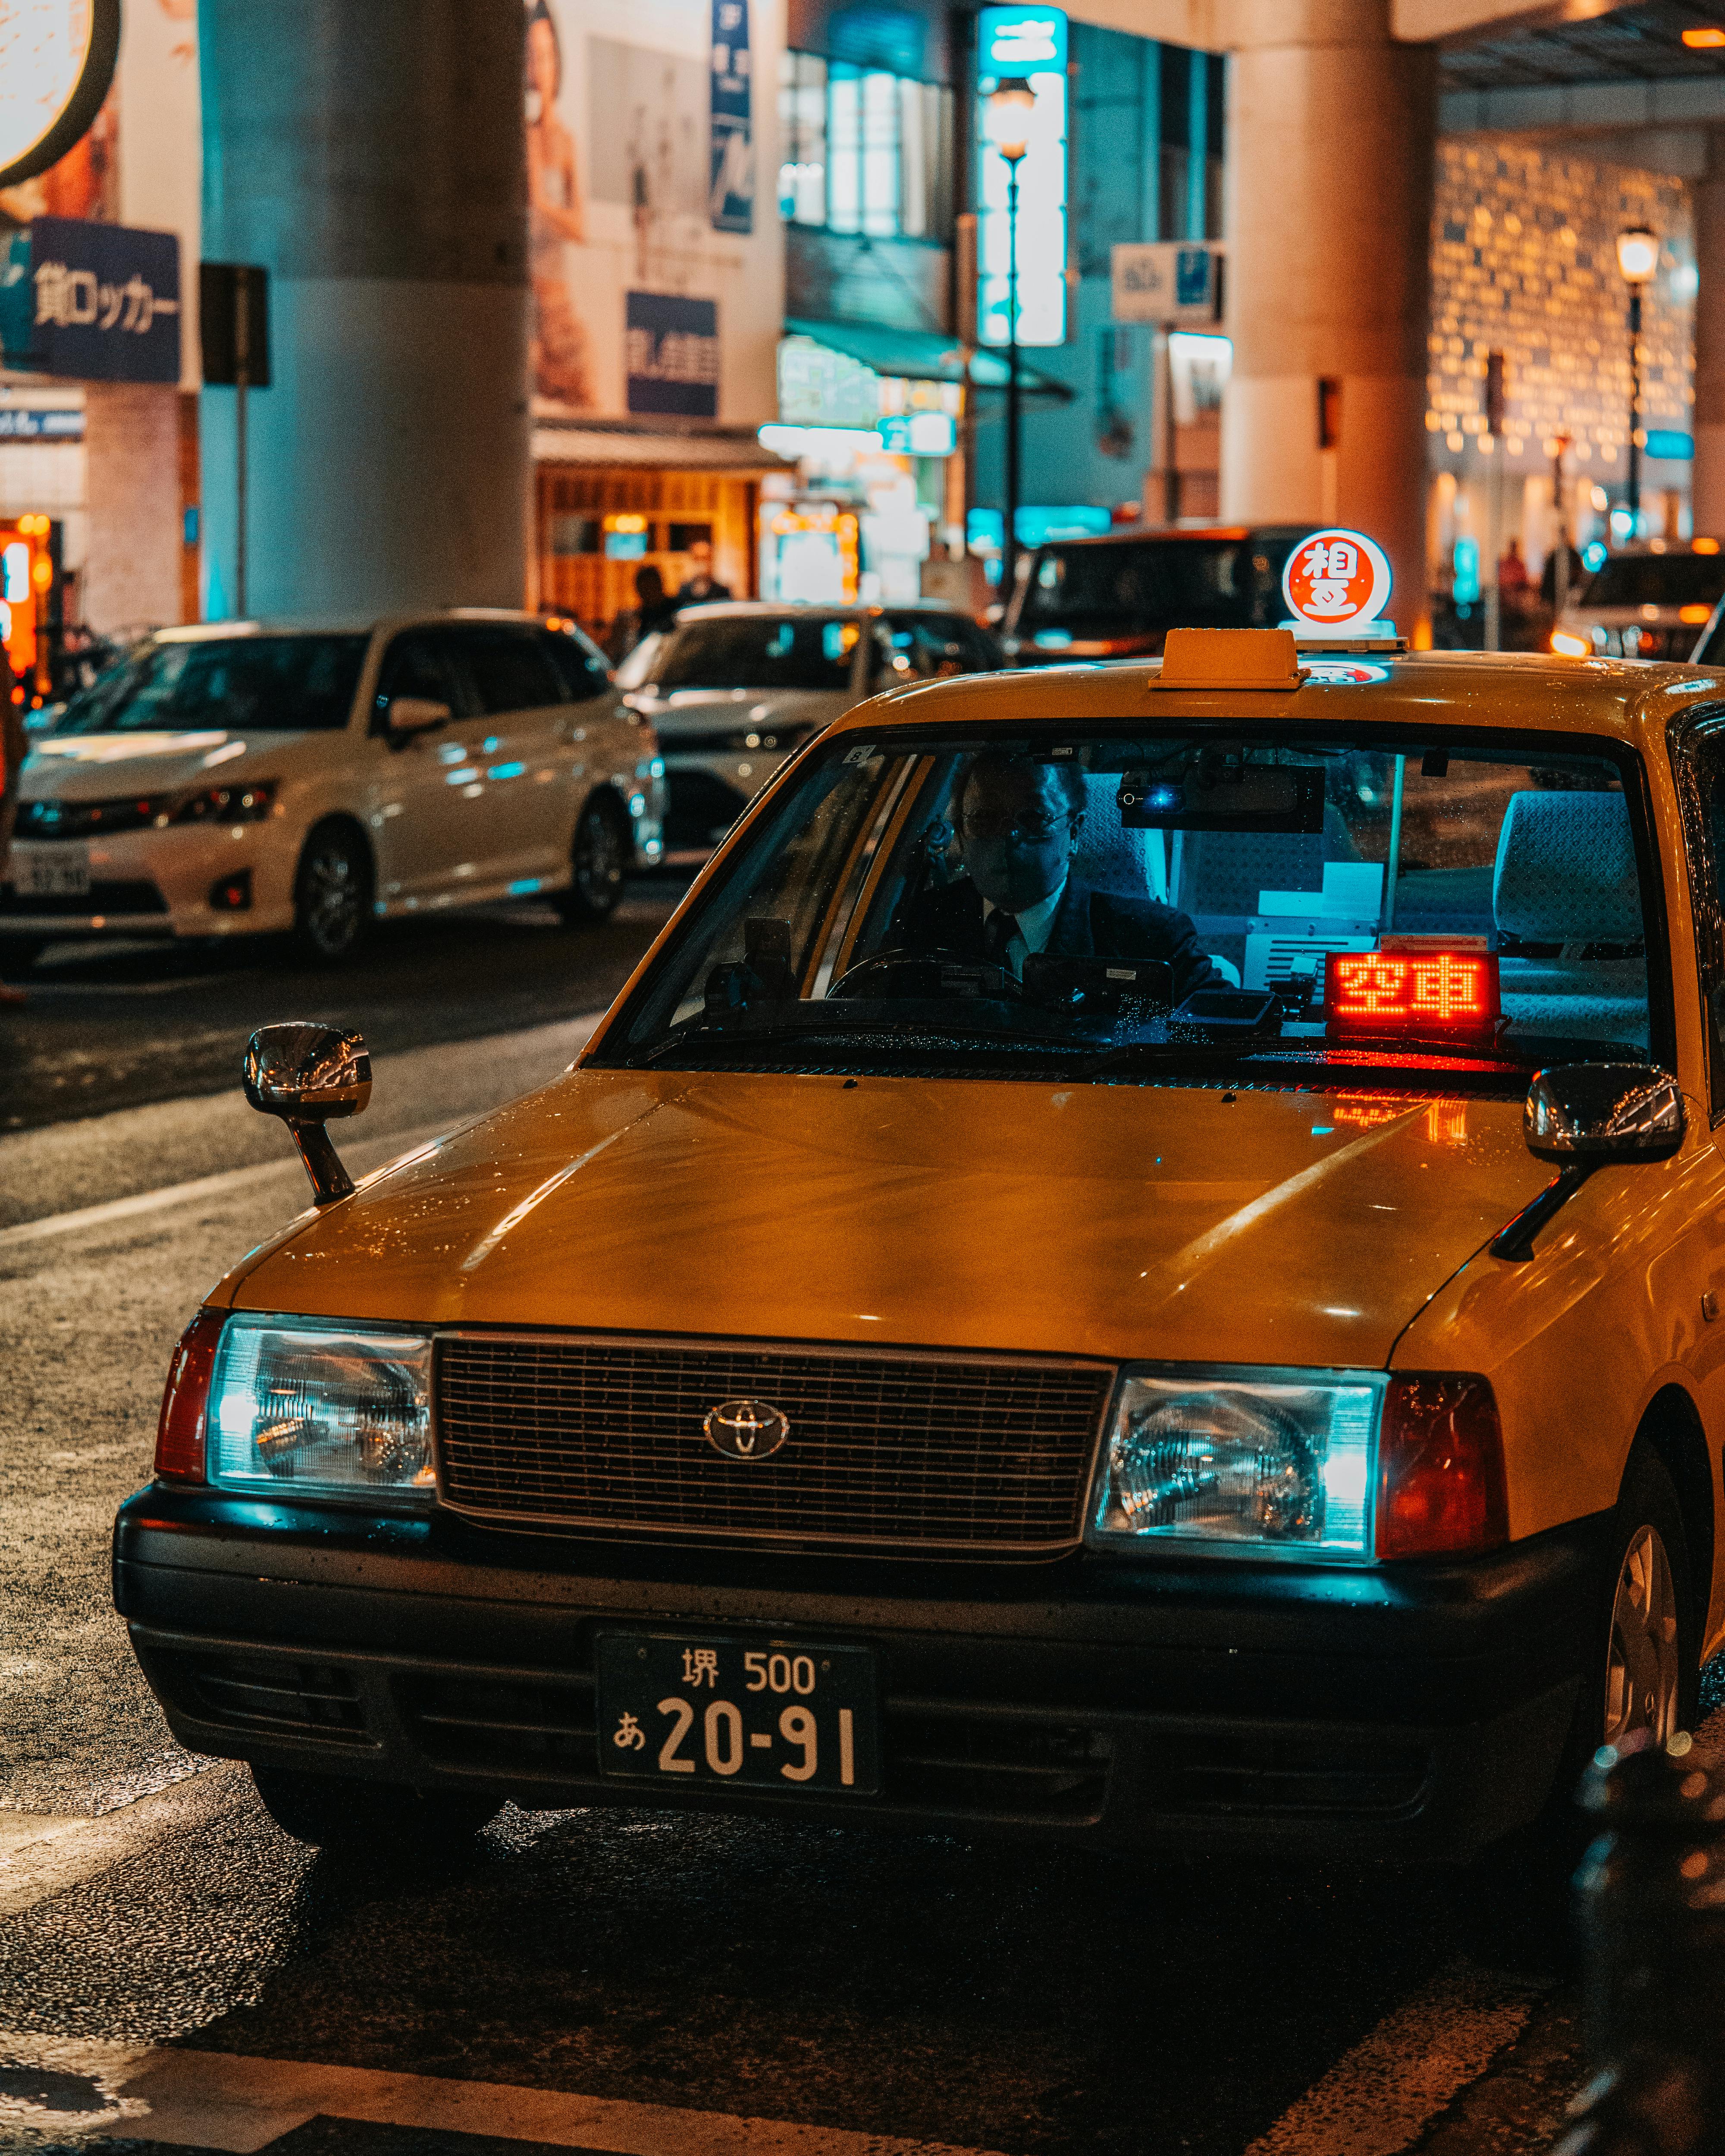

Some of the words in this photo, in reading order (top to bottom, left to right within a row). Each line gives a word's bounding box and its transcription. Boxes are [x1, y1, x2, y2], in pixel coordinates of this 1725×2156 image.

[1302, 541, 1358, 616] 相互
[1337, 954, 1479, 1019] 空車
[682, 1647, 720, 1688] 堺
[744, 1652, 816, 1695] 500
[613, 1711, 646, 1750] あ
[656, 1697, 854, 1786] 20-91
